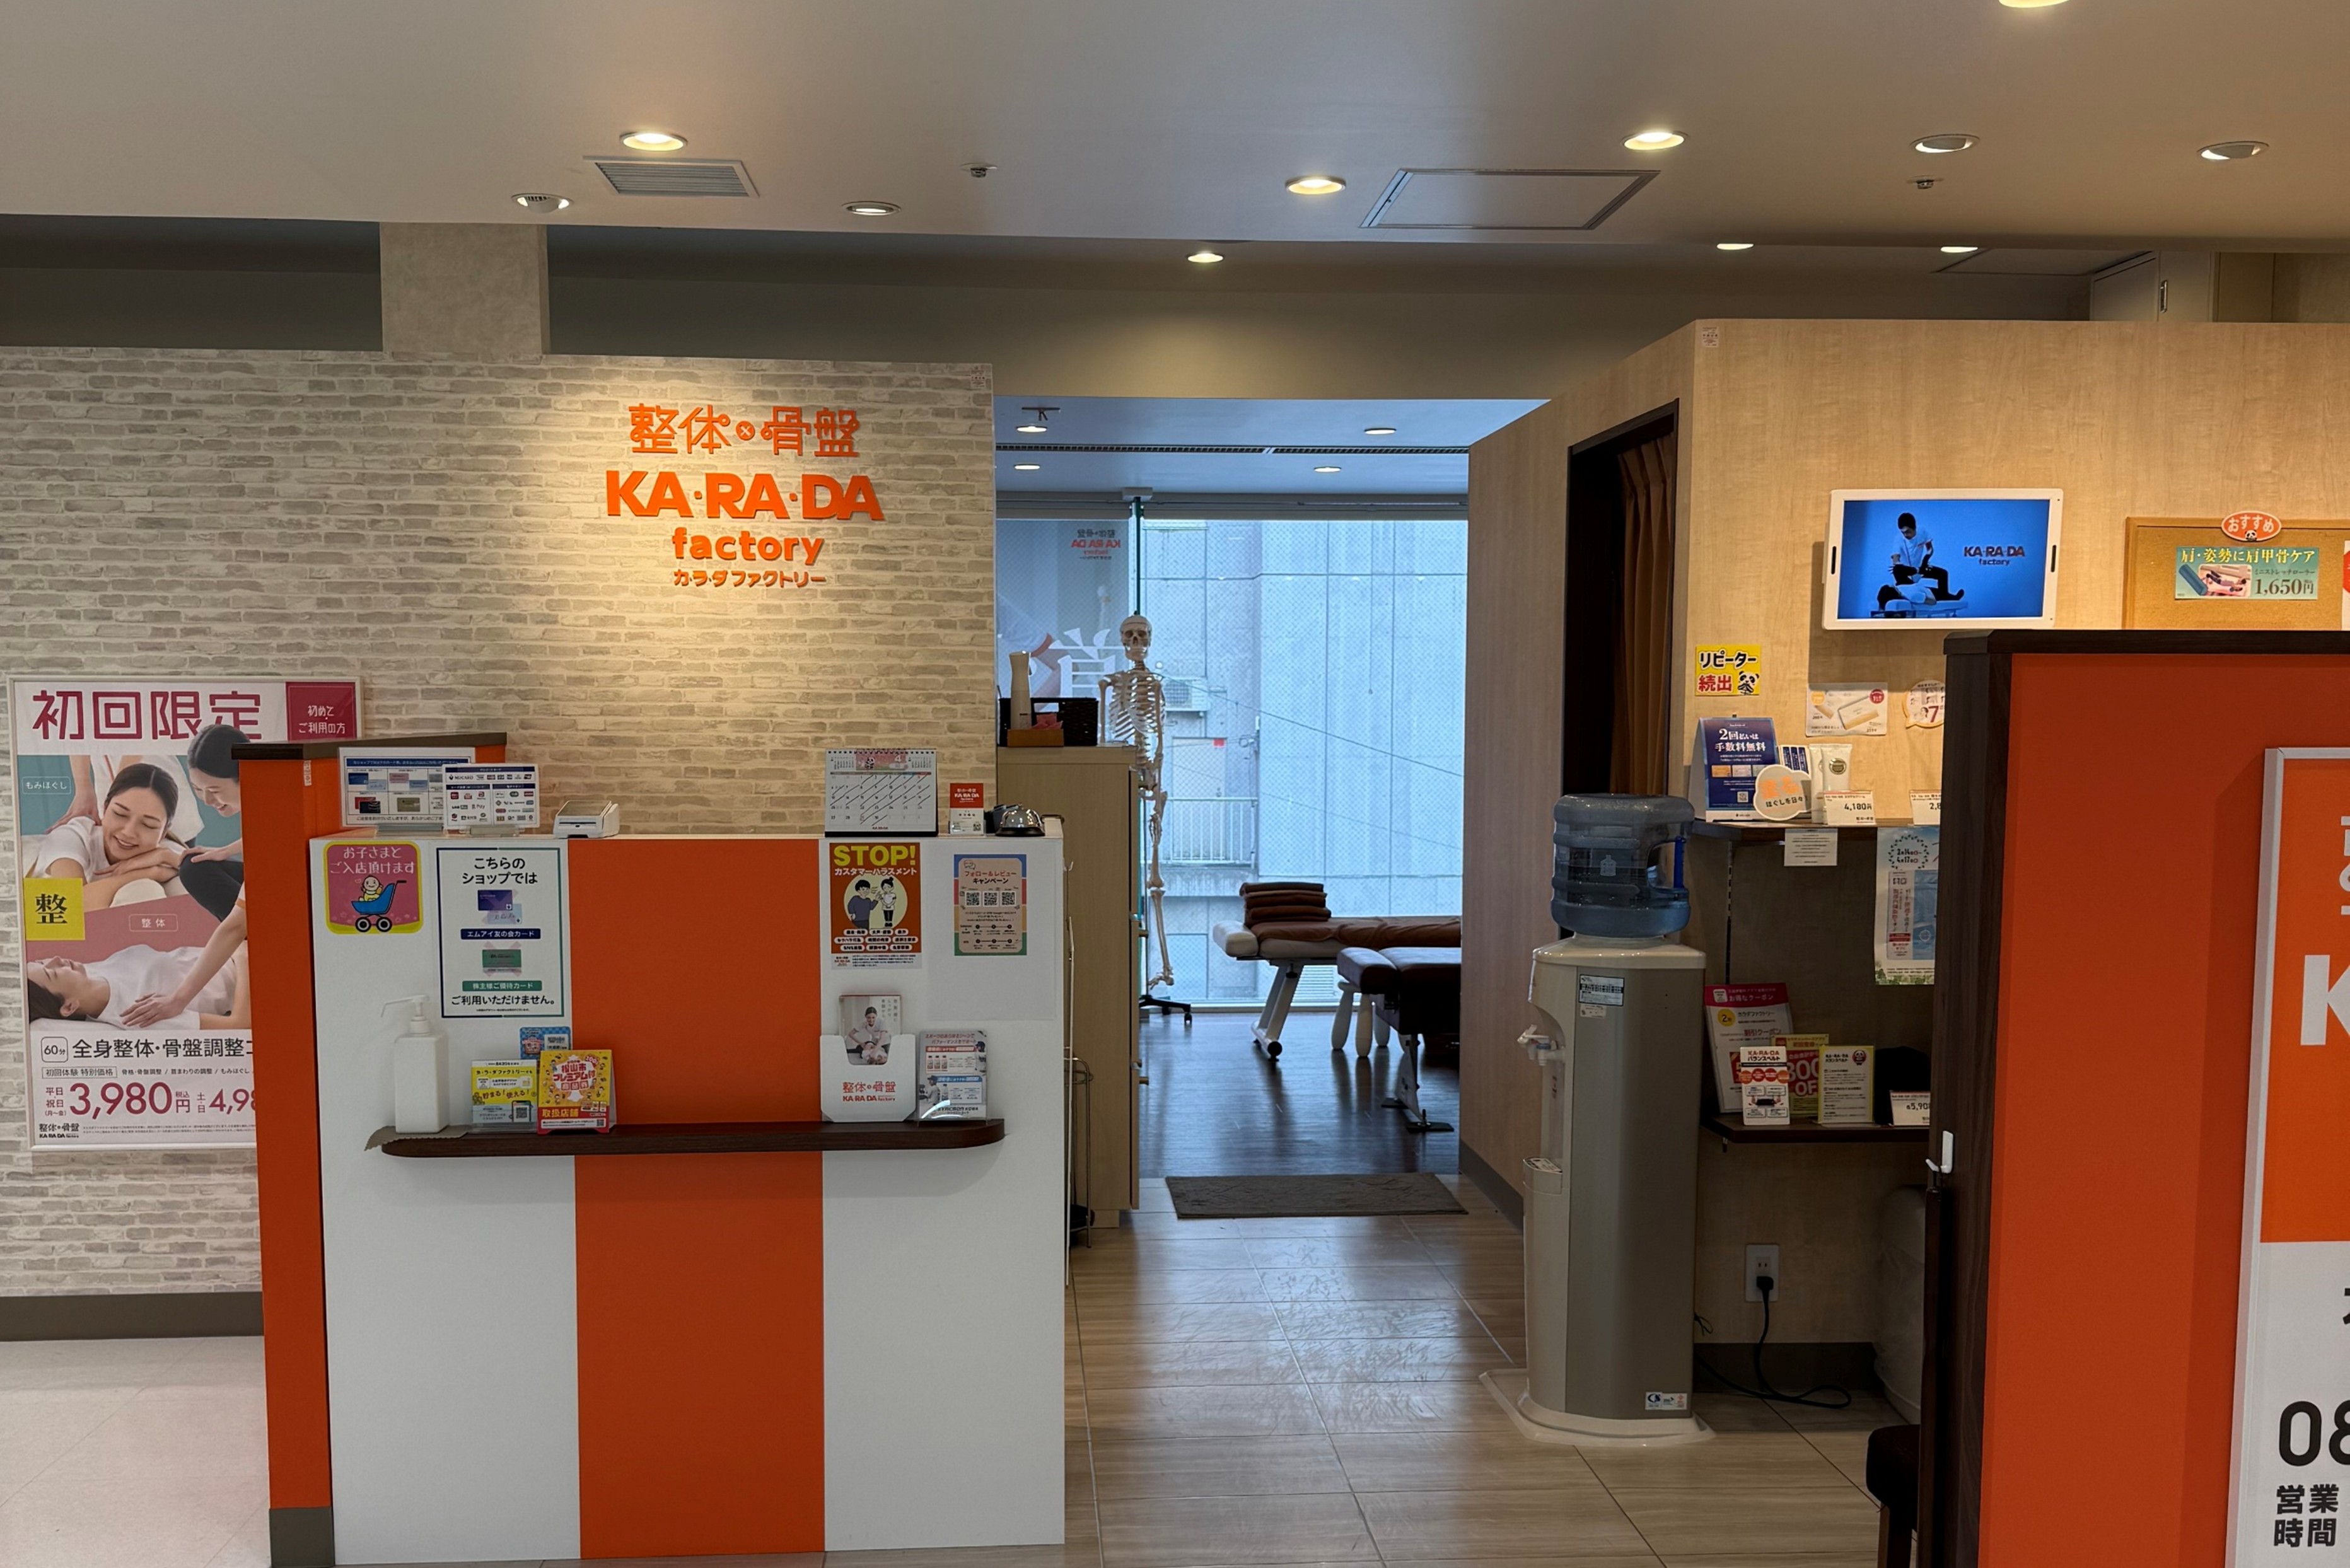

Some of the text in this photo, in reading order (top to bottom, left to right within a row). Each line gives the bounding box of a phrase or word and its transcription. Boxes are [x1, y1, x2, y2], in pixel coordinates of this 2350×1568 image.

[2228, 514, 2275, 532] おすすめ
[672, 527, 825, 566] factory
[1979, 557, 2010, 566] factory
[2181, 549, 2315, 564] 肩・姿勢に肩甲骨ケア
[1699, 651, 1757, 669] リピーター
[1698, 674, 1733, 692] 続出
[32, 690, 262, 740] 初回限定
[307, 706, 335, 717] 初めて
[298, 722, 346, 735] ご利用の方
[1715, 741, 1766, 752] 手数料無料
[25, 781, 67, 790] もみほぐし
[342, 847, 402, 859] お子さまと
[834, 845, 916, 866] STOP!
[330, 861, 415, 874] ご入店頂けます
[474, 857, 526, 870] こちらの
[462, 871, 538, 885] ショップでは
[834, 867, 917, 876] カスタマーハラスメント
[35, 893, 68, 924] 整
[141, 918, 166, 929] 整体
[451, 995, 555, 1006] ご利用いただけません。
[44, 1044, 66, 1056] 60分
[46, 1068, 113, 1077] 初回体験 特別価格
[2276, 1484, 2339, 1515] 営業
[2273, 1518, 2337, 1547] 時間
